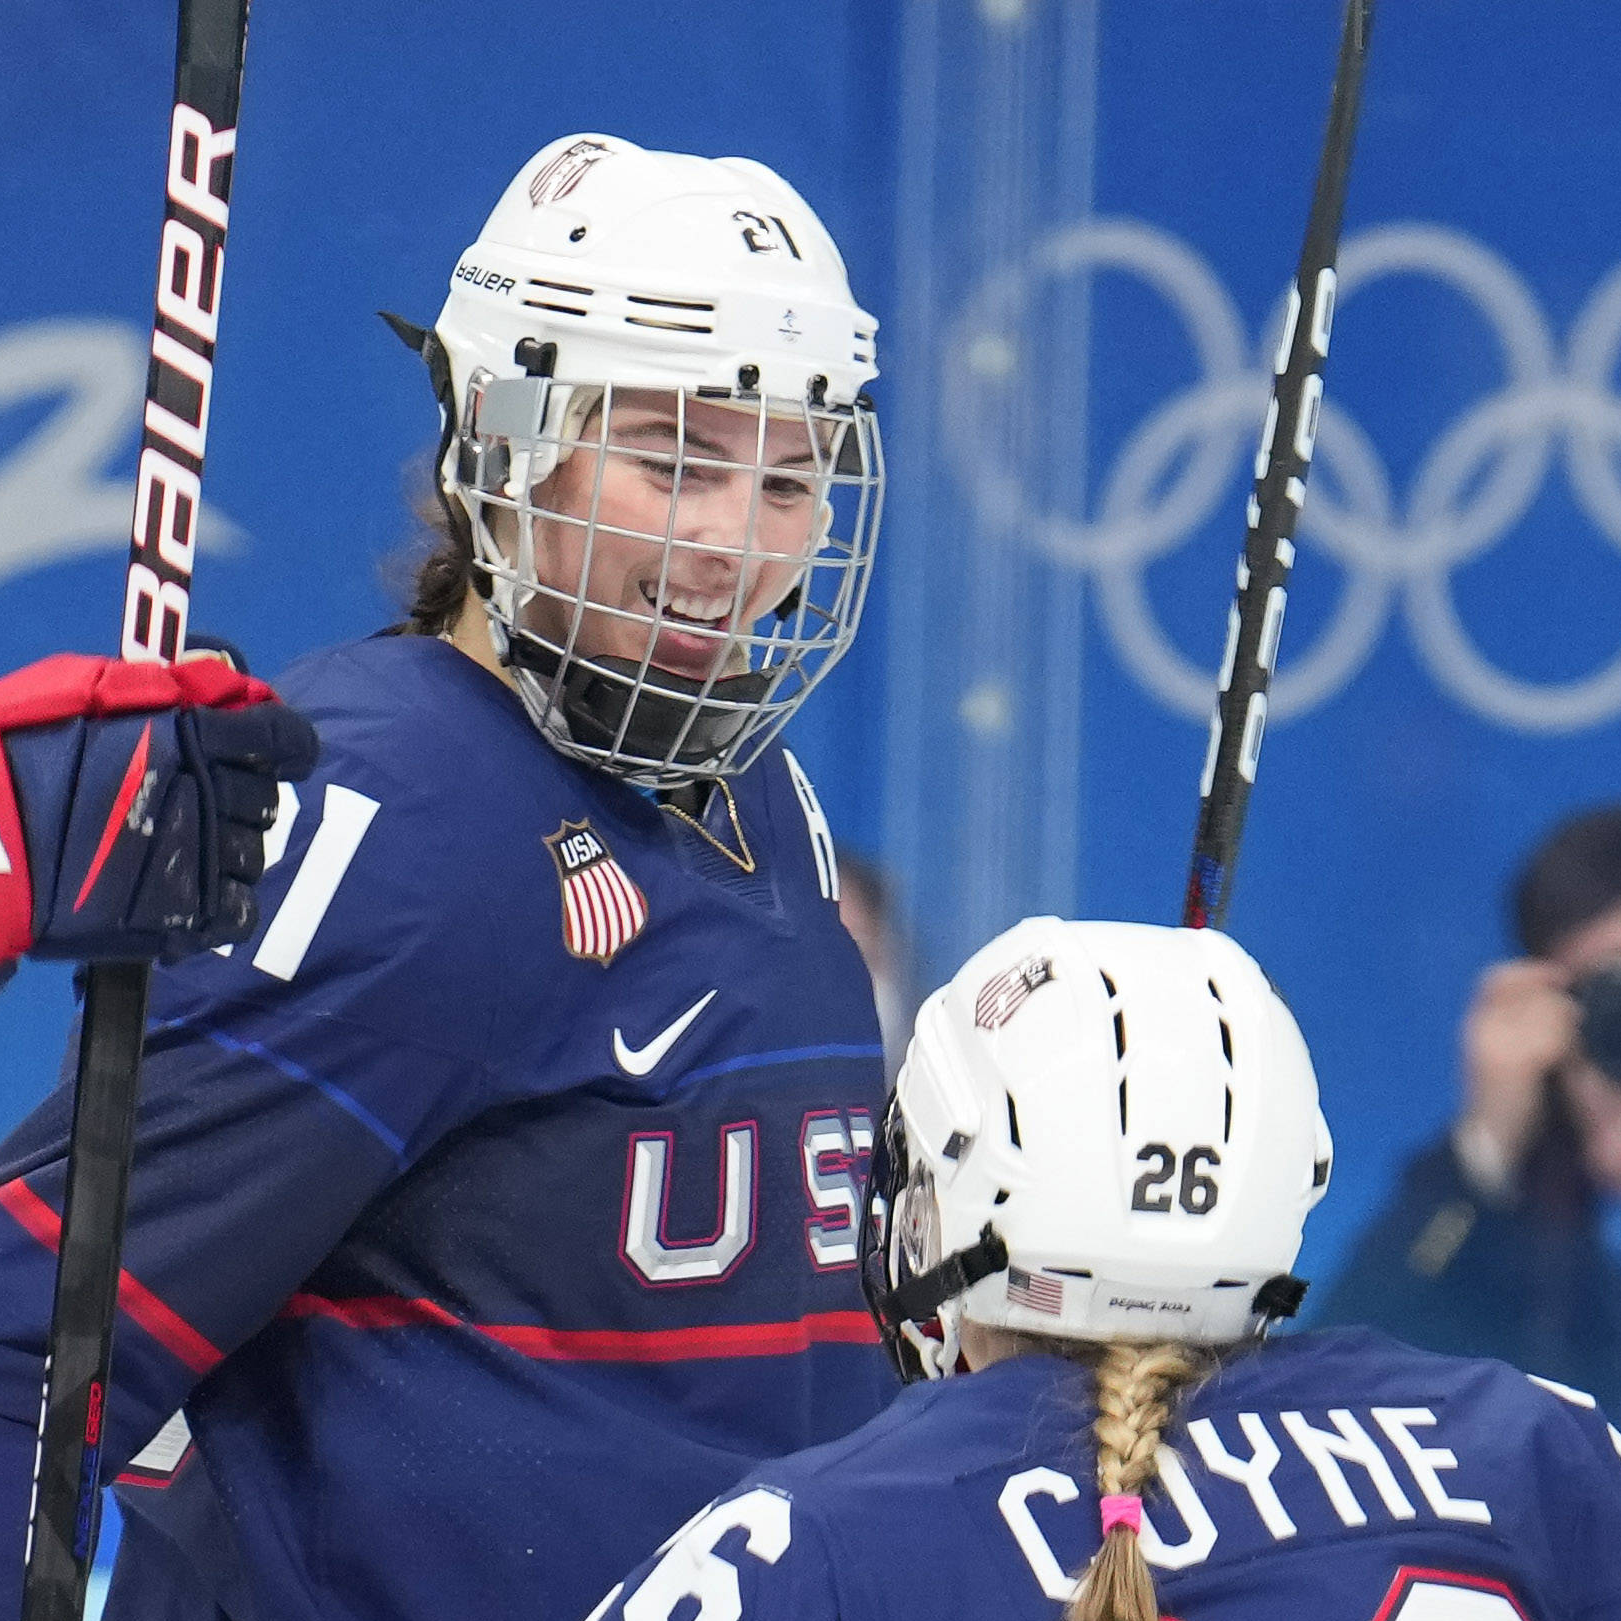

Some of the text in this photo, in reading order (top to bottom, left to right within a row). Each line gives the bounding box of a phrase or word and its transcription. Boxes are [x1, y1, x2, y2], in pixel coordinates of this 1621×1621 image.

[731, 210, 803, 261] 21
[560, 831, 603, 869] USA
[1130, 1142, 1222, 1215] 26
[997, 1406, 1493, 1602] COYNE
